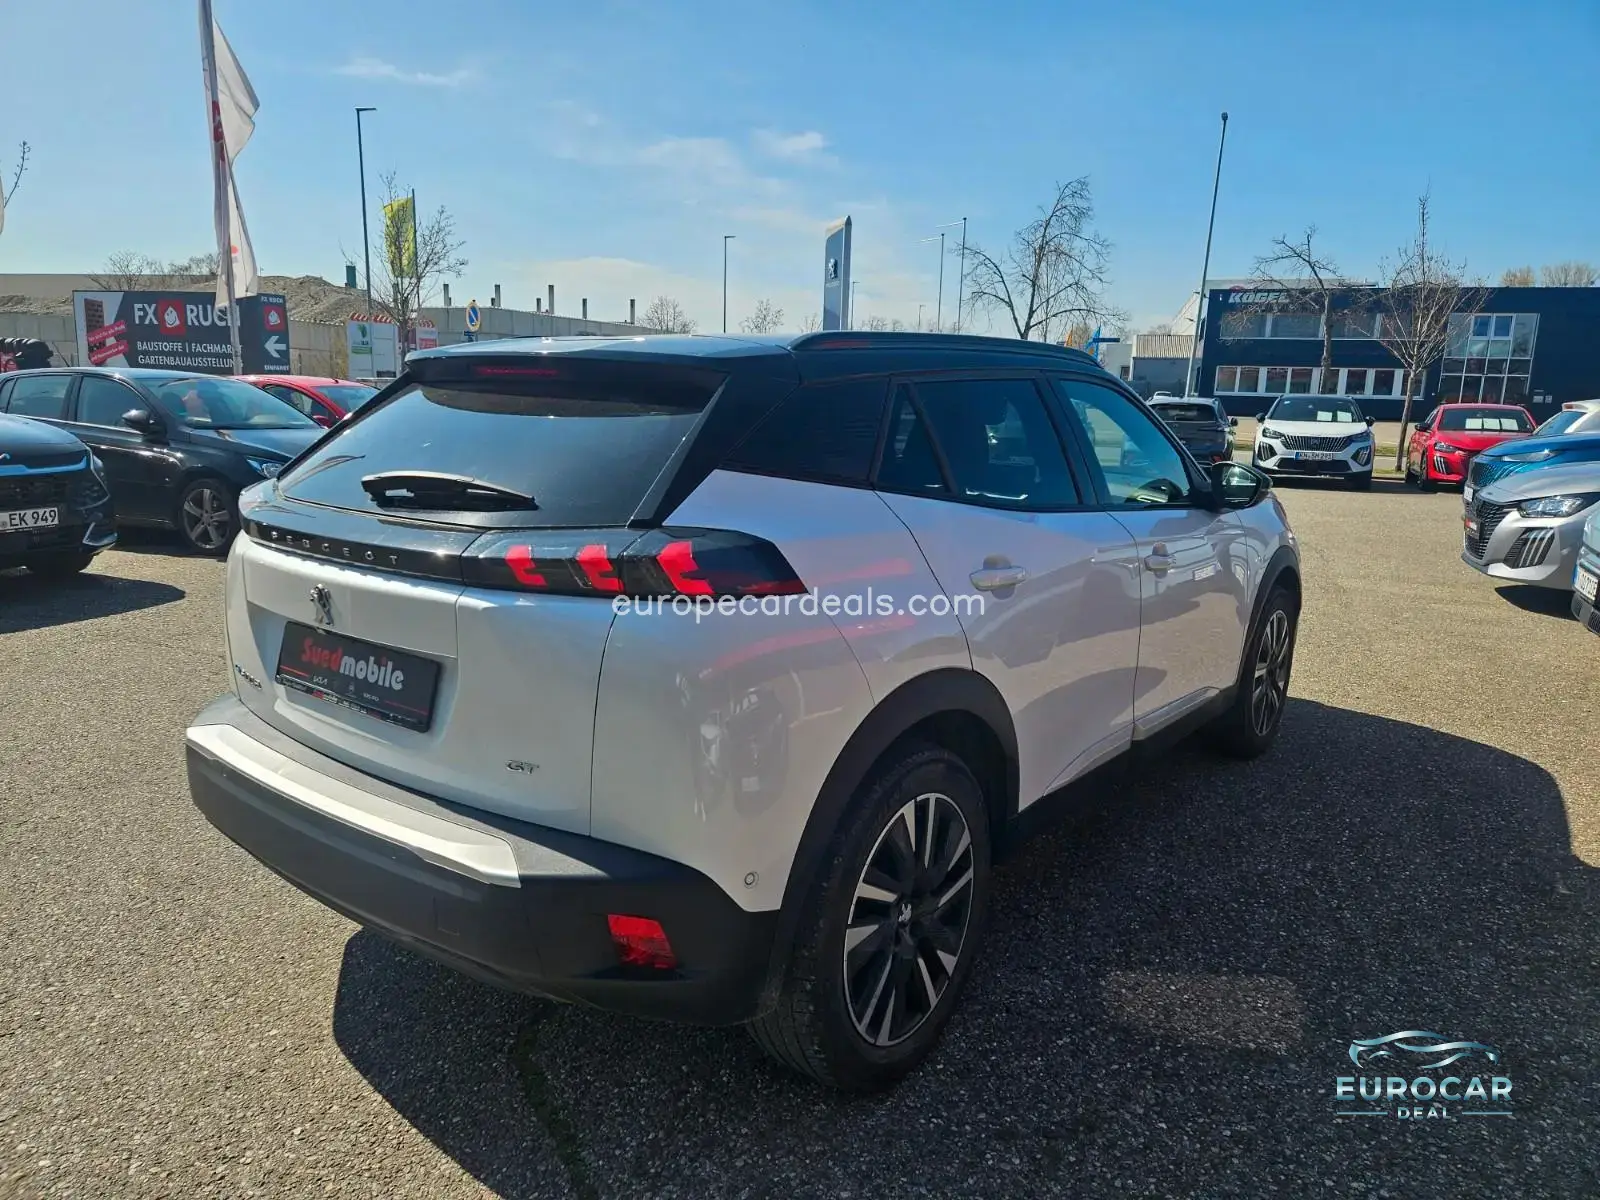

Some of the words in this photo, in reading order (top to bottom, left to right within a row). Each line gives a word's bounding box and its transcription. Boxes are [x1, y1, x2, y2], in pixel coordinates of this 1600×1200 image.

[133, 303, 159, 325] FX
[137, 341, 183, 352] BAUSTOFFE
[191, 343, 244, 355] FACHMART
[138, 355, 244, 368] GARTENBAUAUSSTELLUN
[9, 512, 29, 527] EK
[31, 509, 57, 525] 949
[270, 530, 399, 566] PEUGEOT
[301, 637, 404, 691] Suedmobile
[505, 759, 540, 775] GT
